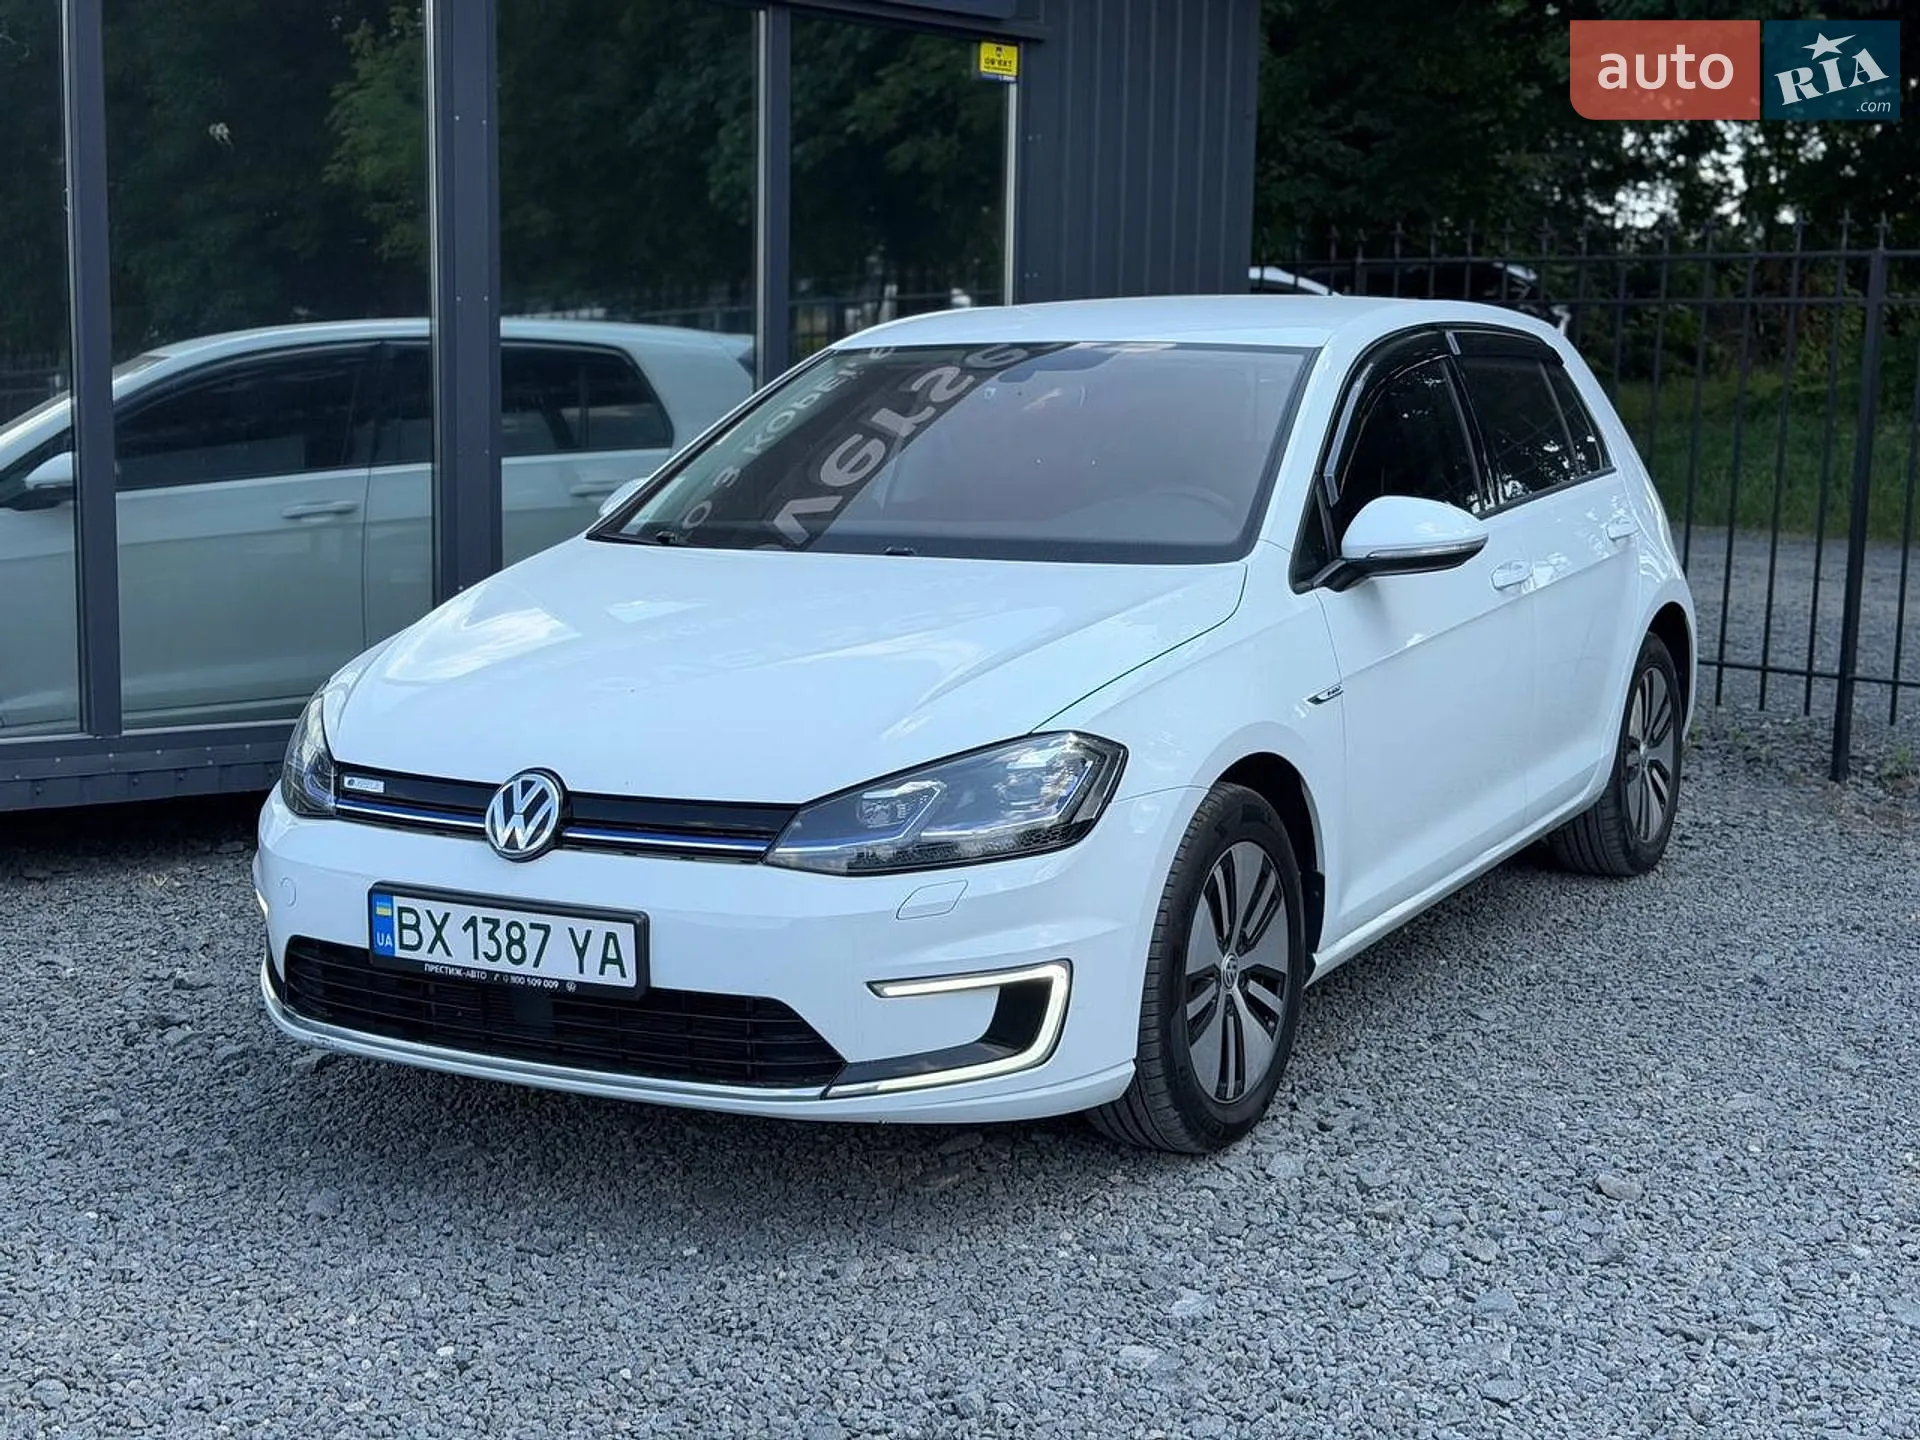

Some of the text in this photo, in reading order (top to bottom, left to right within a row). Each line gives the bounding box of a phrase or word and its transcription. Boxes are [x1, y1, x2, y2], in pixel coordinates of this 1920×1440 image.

[376, 931, 394, 948] UA
[397, 906, 627, 978] BX 1387 YA
